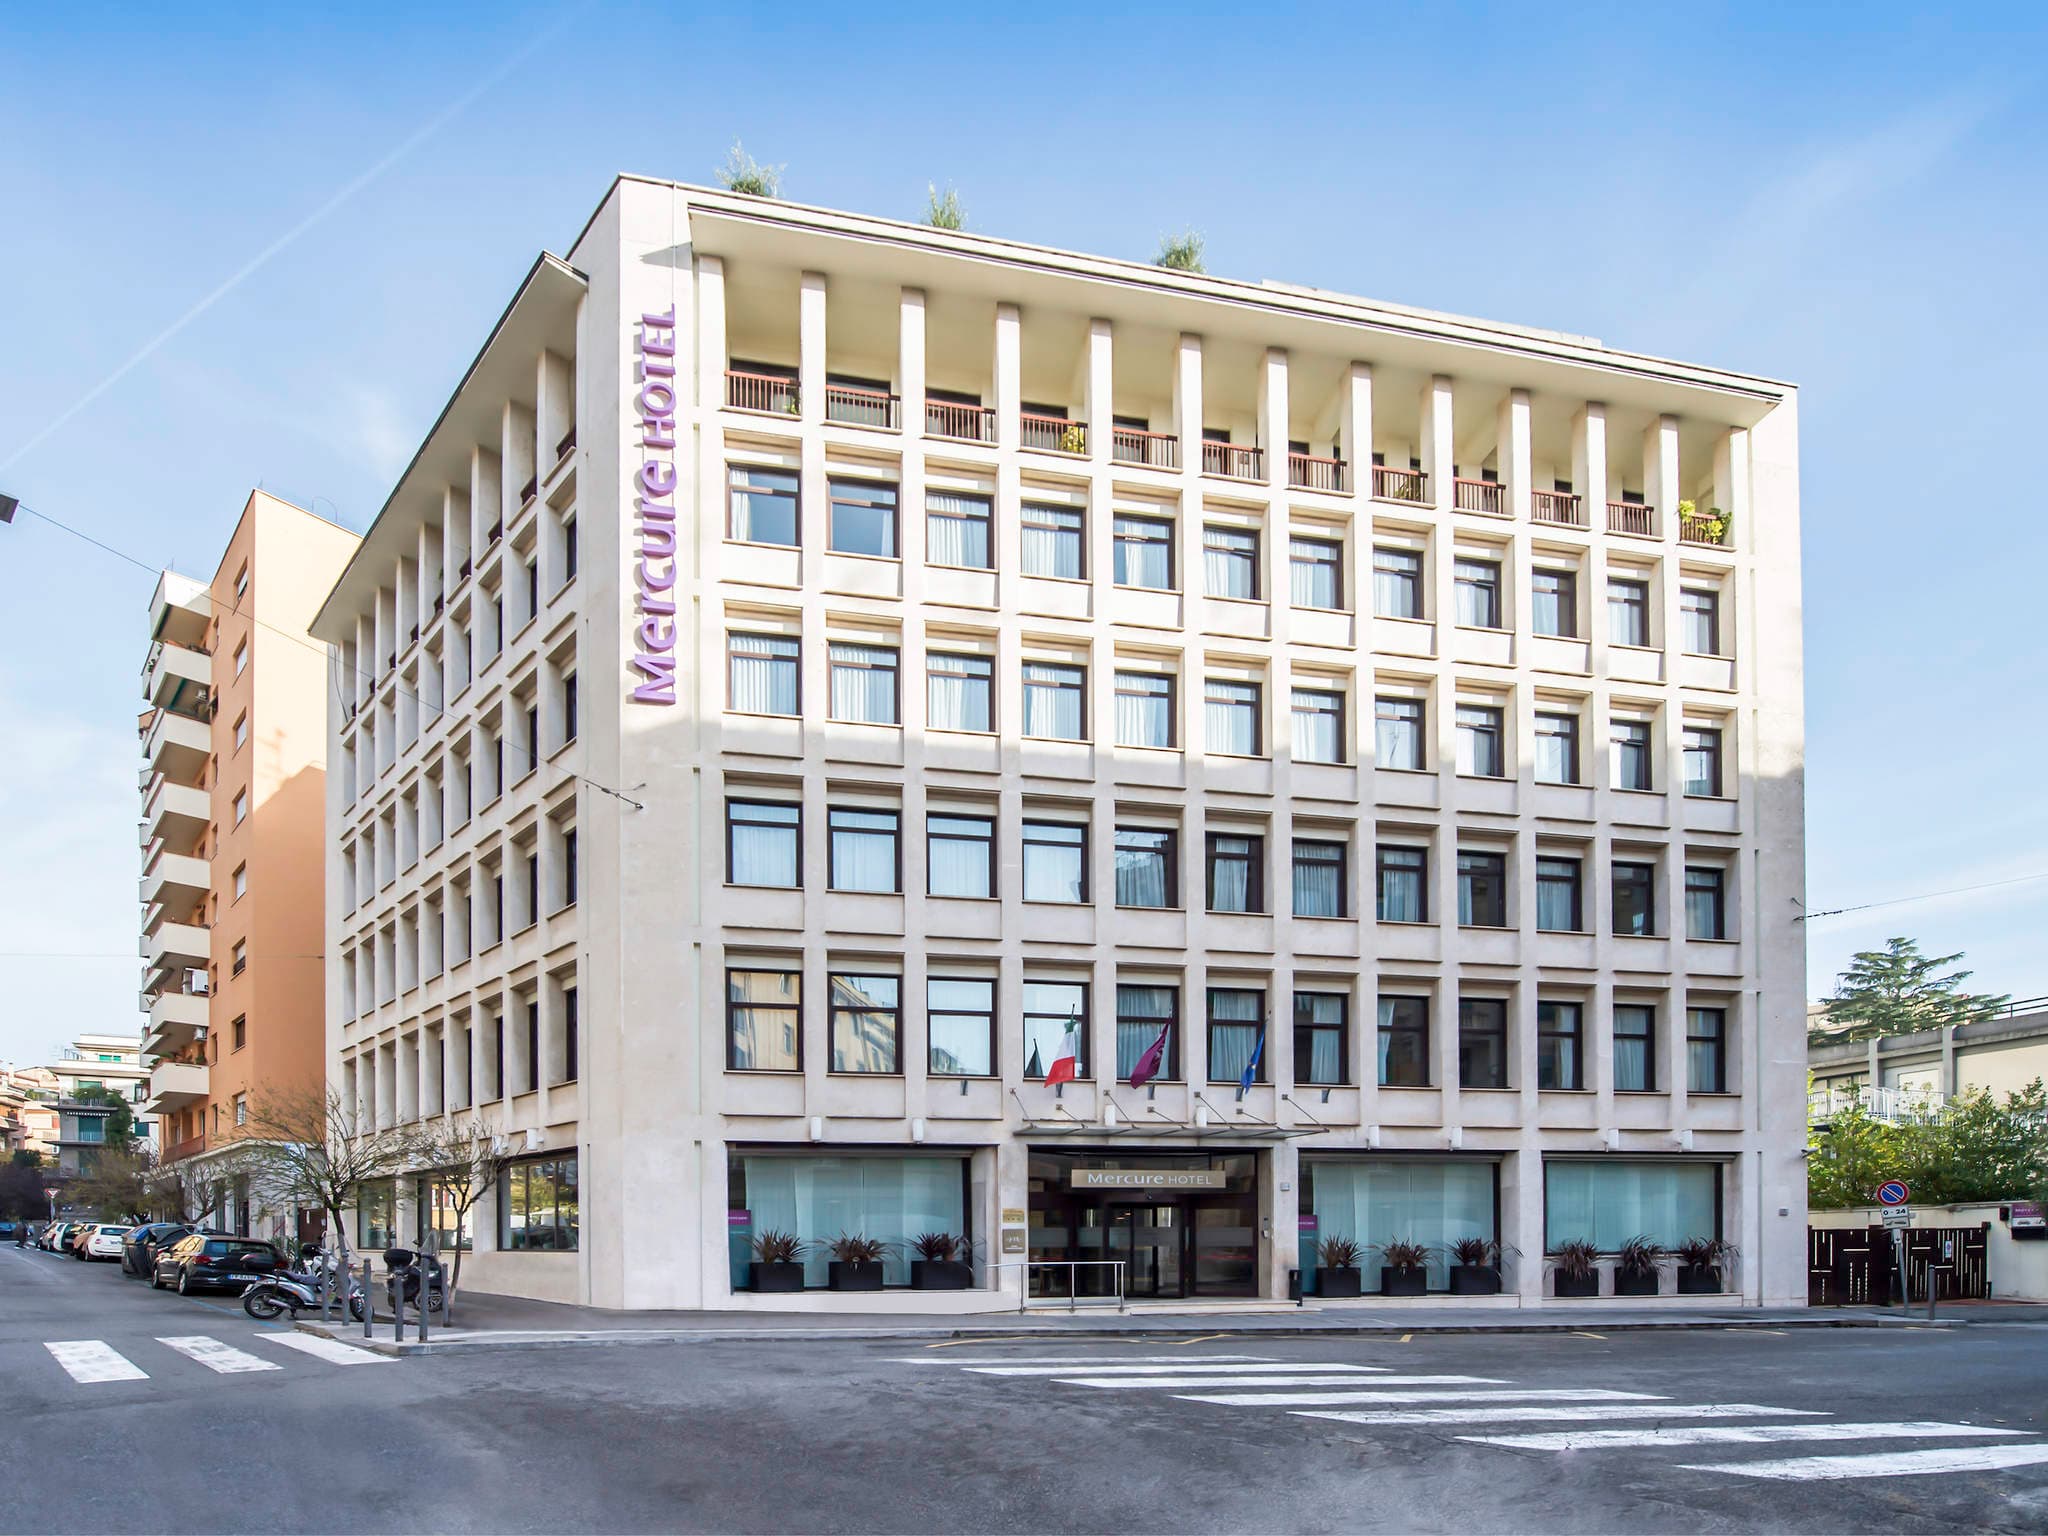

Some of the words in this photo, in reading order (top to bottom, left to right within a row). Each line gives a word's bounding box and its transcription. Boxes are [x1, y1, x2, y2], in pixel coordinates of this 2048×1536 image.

[640, 302, 677, 449] HOTEL
[634, 459, 679, 705] Mercure
[1087, 1172, 1164, 1185] Mercure
[1168, 1174, 1212, 1185] HOTEL
